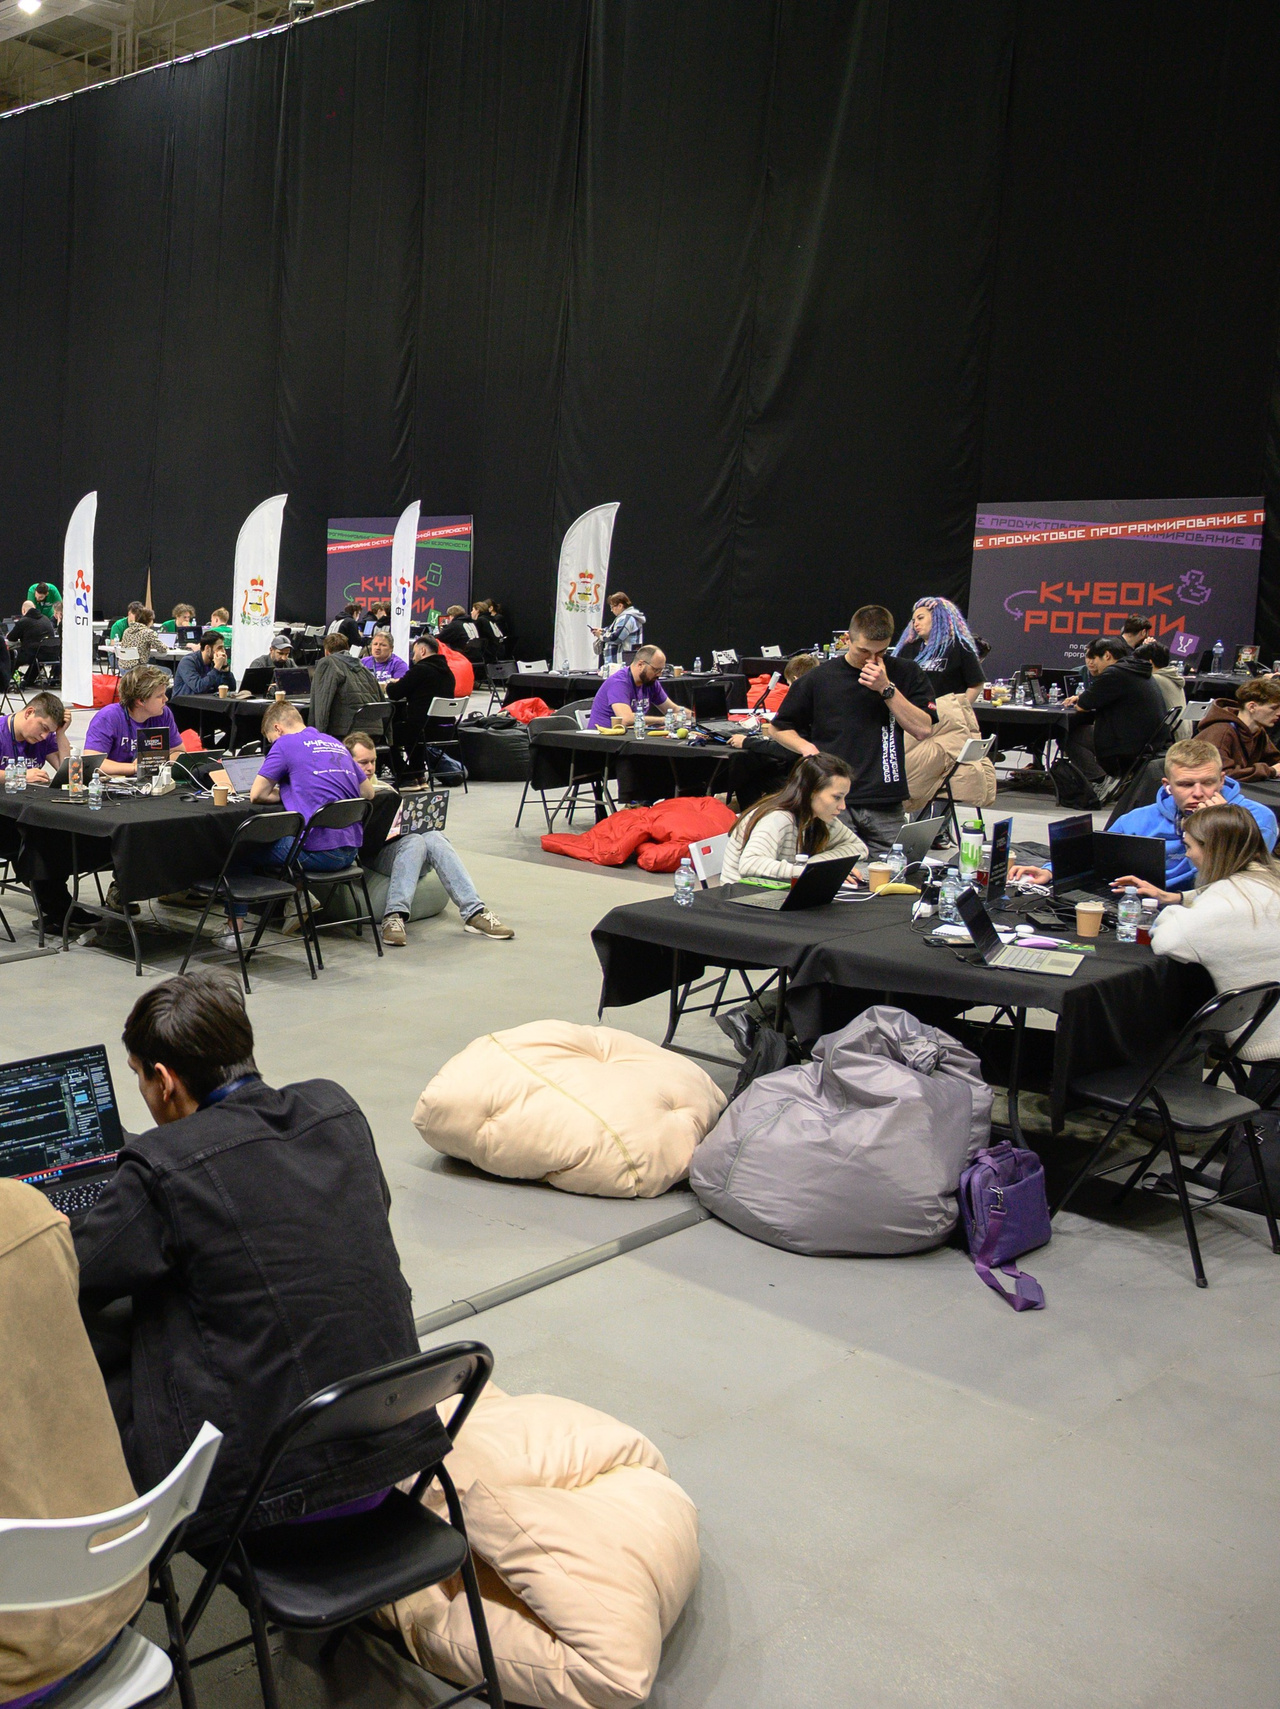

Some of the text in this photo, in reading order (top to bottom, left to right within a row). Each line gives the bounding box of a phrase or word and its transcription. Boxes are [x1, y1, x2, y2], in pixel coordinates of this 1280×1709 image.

[988, 530, 1086, 546] ПРОДУКТОВОЕ
[1090, 514, 1247, 538] ПРОГРАММИРОВАНИЕ
[990, 518, 1086, 530] ПРОДУКТОВО
[361, 576, 428, 592] КУК
[1040, 581, 1174, 606] КУБОК
